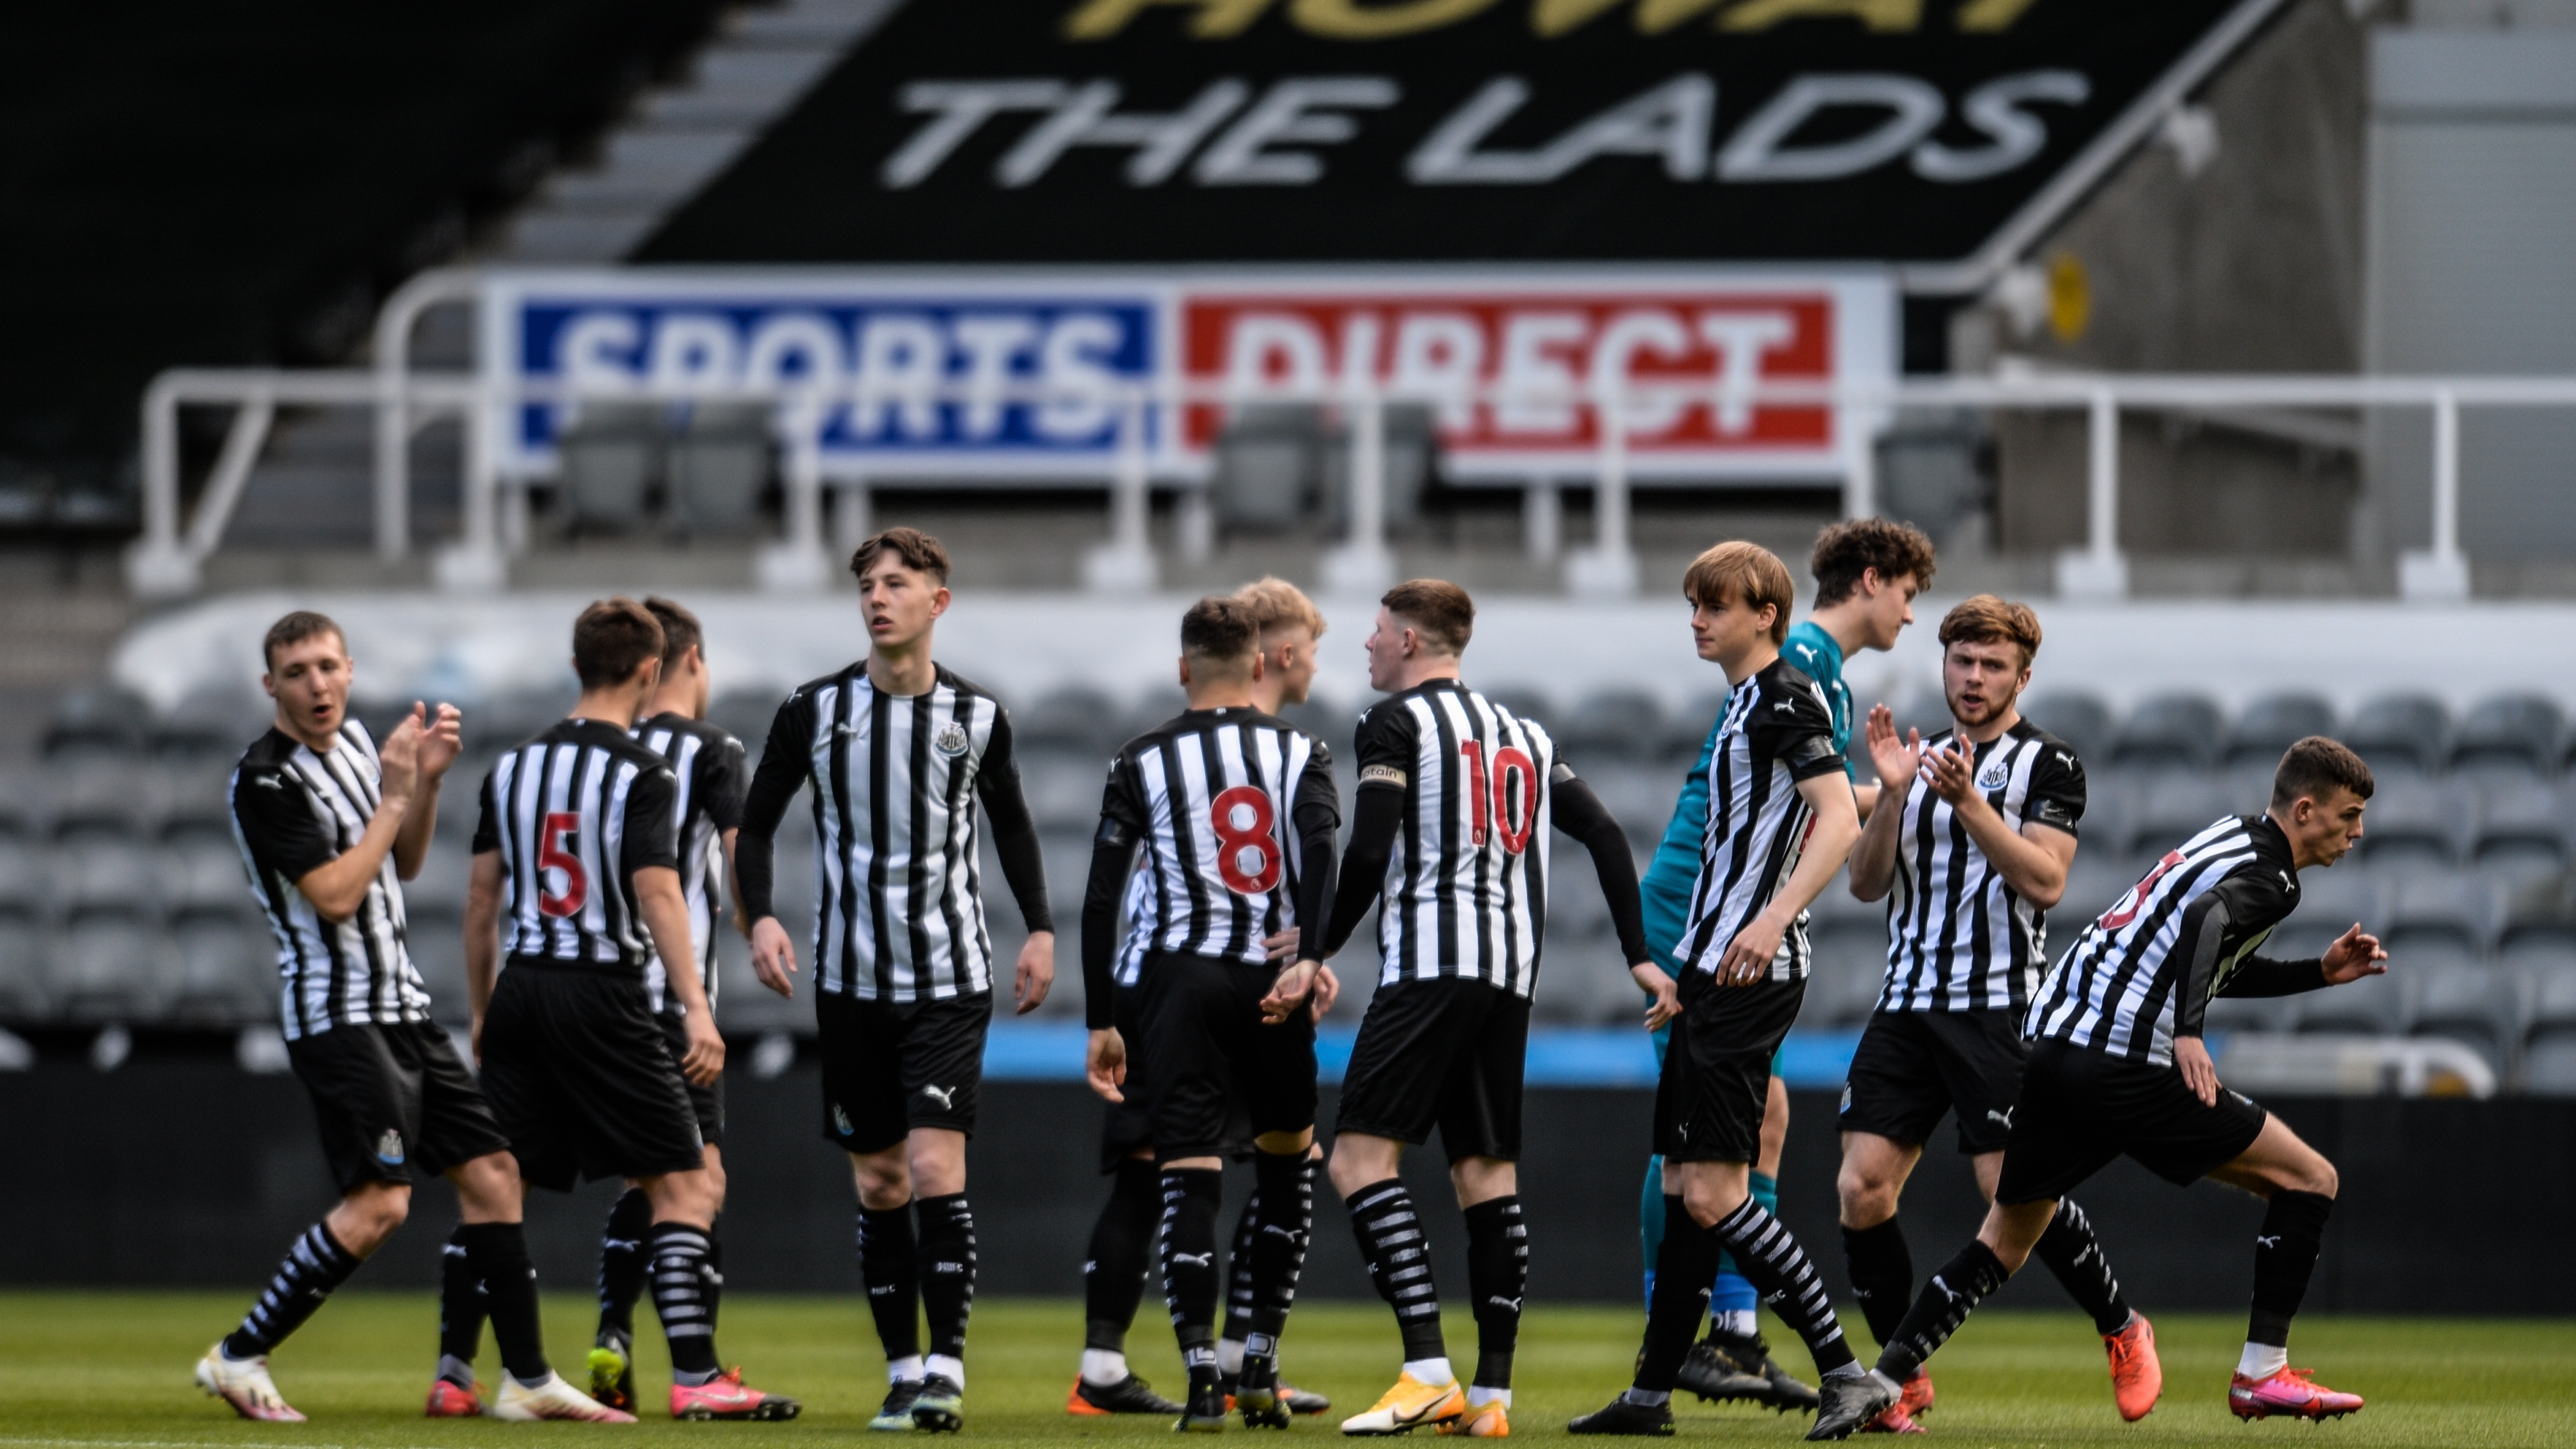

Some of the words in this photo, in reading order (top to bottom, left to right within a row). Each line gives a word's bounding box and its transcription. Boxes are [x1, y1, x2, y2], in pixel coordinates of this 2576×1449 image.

[880, 74, 1401, 189] THE
[1406, 69, 2091, 185] LADS
[557, 311, 1127, 439] SPORTS
[1218, 310, 1799, 436] DIRECT
[1210, 785, 1282, 895] 8
[1460, 738, 1537, 856] 10
[539, 812, 588, 918] 5
